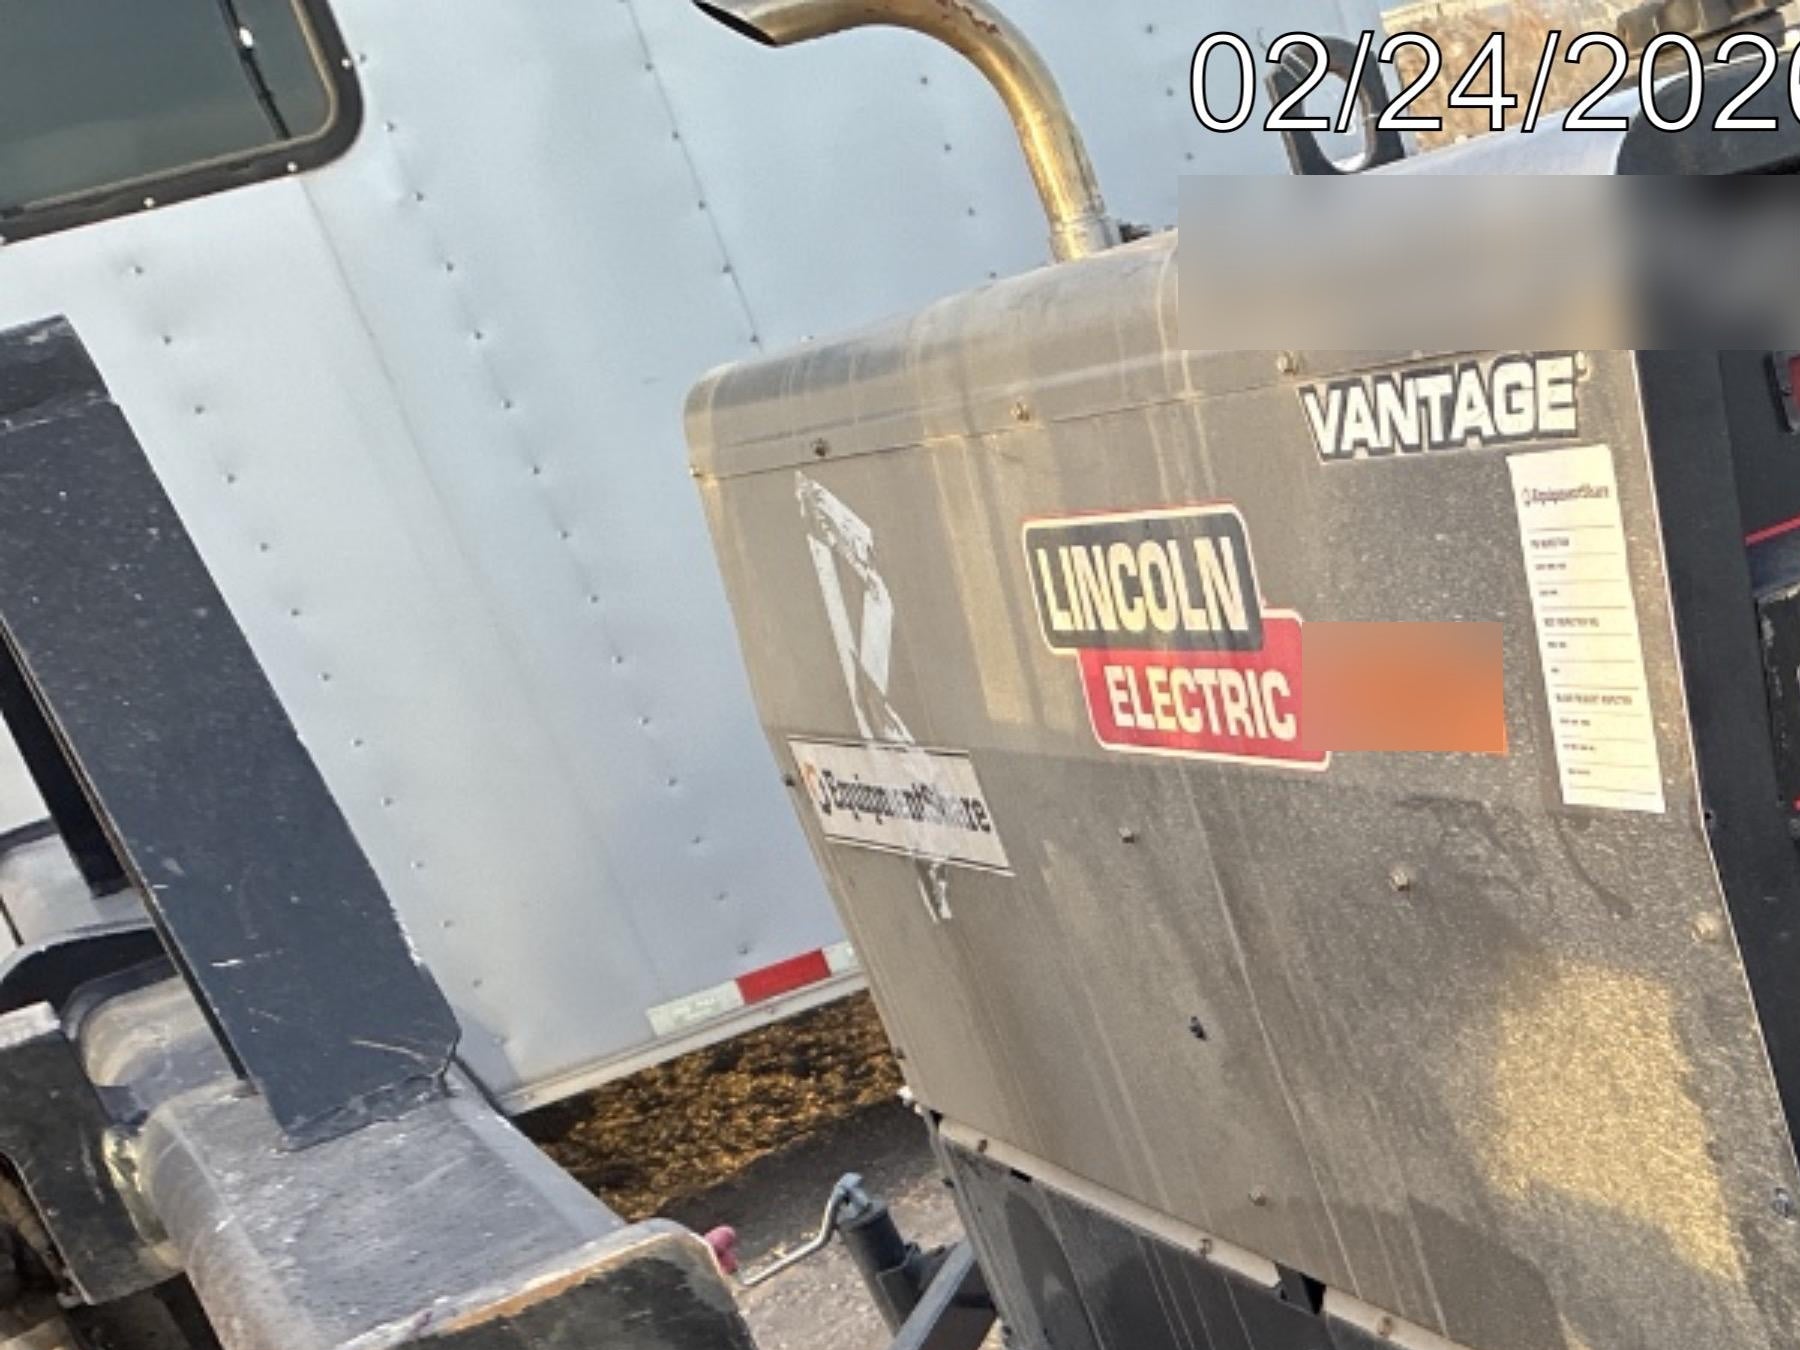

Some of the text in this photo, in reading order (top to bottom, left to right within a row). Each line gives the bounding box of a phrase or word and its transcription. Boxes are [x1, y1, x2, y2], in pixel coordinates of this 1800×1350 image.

[1301, 354, 1579, 457] VANTAGE
[1036, 535, 1249, 633] LINCOLN
[1103, 664, 1297, 740] ELECTRIC
